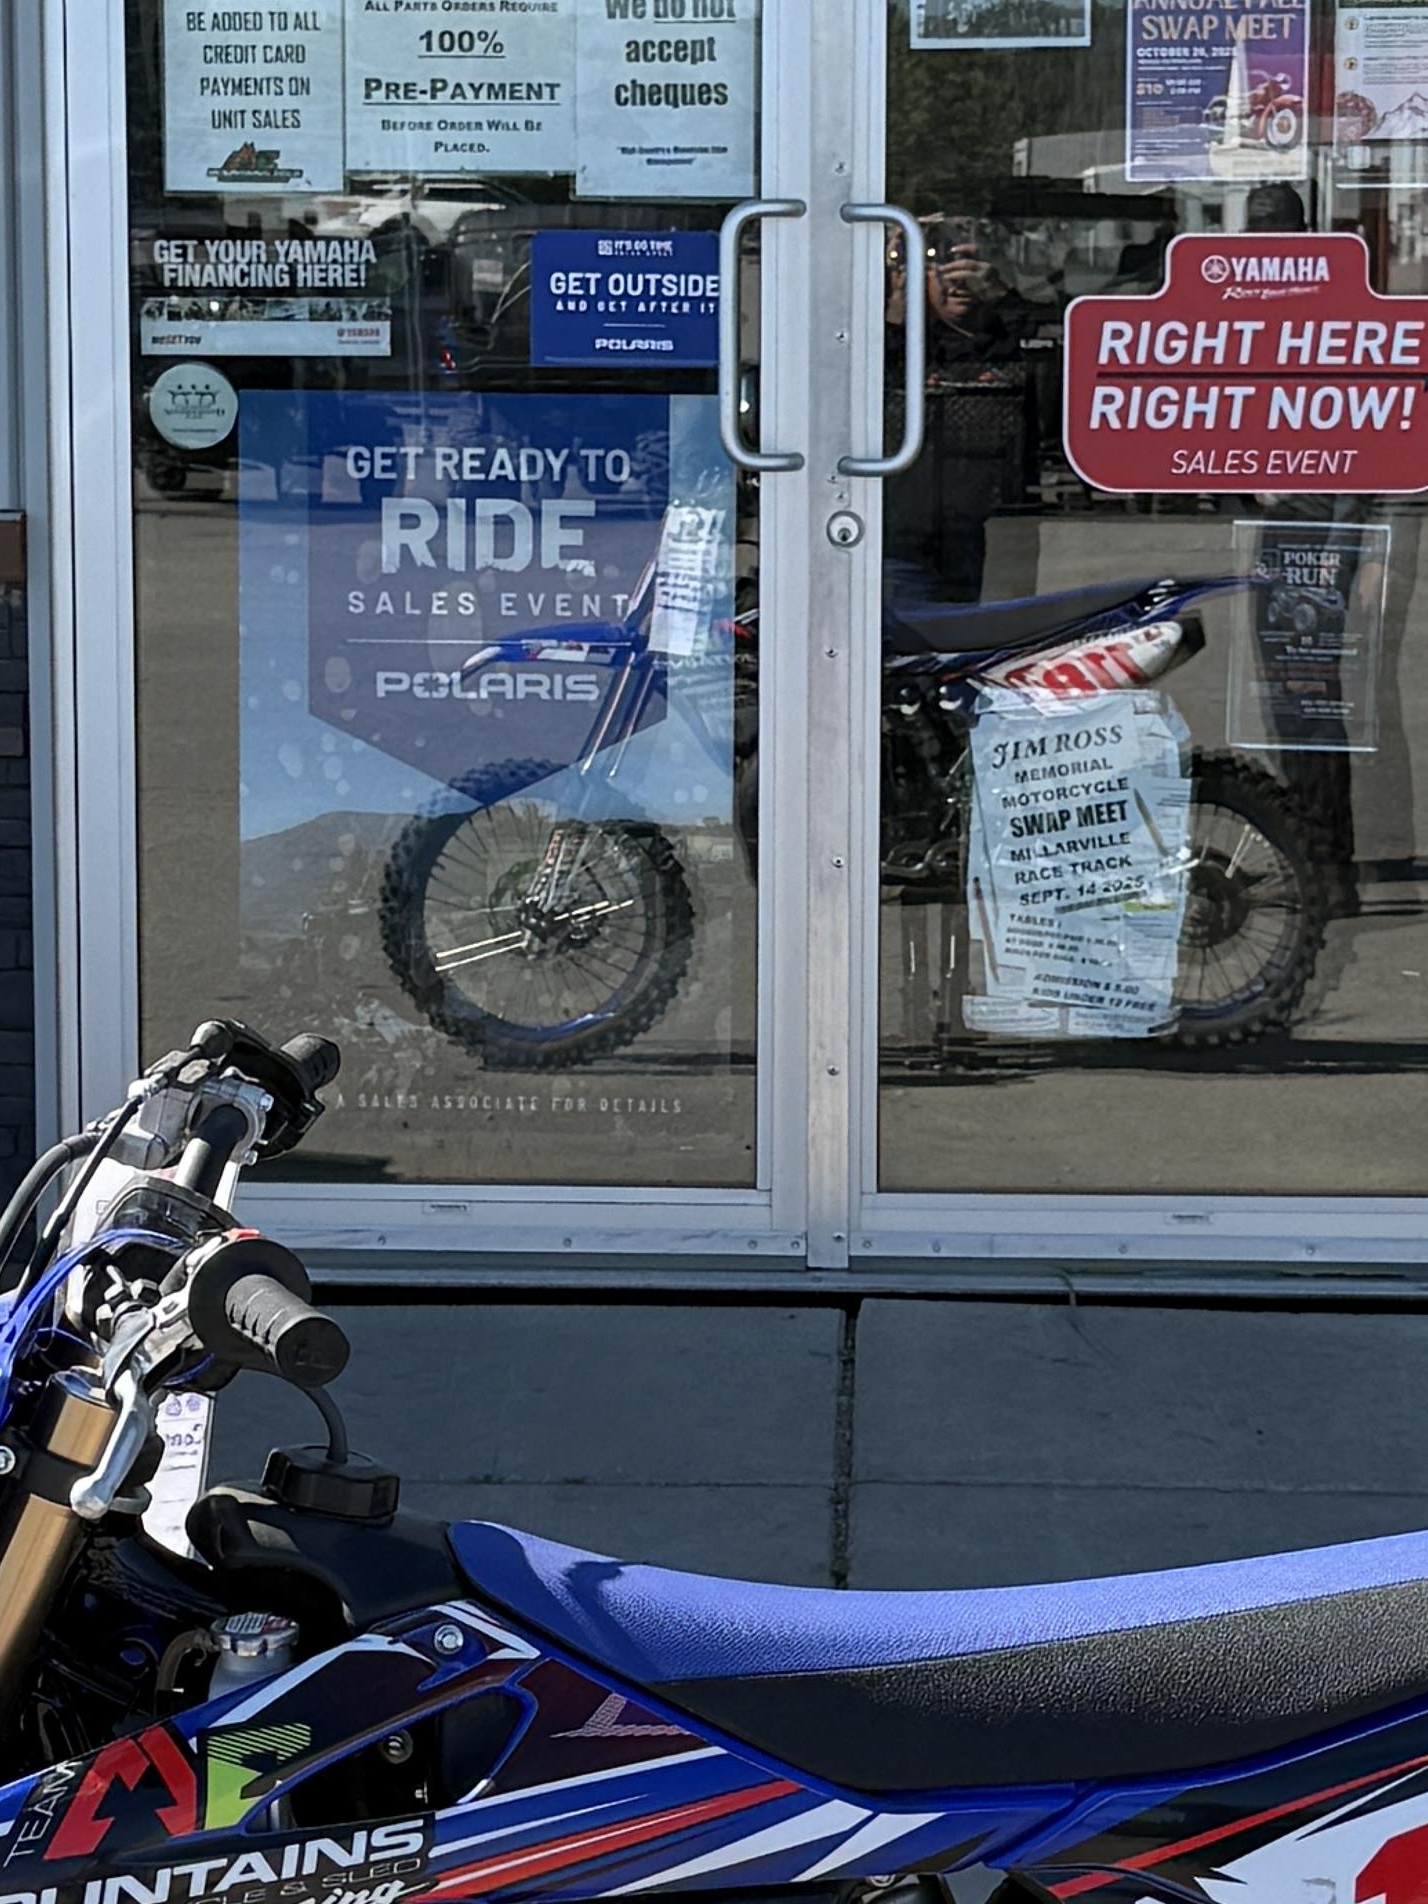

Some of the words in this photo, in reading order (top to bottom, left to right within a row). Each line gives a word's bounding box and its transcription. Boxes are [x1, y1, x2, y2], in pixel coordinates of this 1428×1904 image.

[186, 12, 207, 31] BE
[211, 11, 263, 32] ADDED
[269, 12, 288, 31] TO
[293, 11, 321, 31] ALL
[1141, 15, 1219, 41] SWAP
[1225, 14, 1296, 40] MEET
[203, 44, 257, 64] CREDIT
[263, 44, 306, 64] CARD
[419, 29, 504, 55] 100%
[625, 36, 717, 65] accept
[1136, 47, 1190, 57] OCTOBER
[200, 77, 284, 96] PAYMENTS
[289, 77, 311, 96] ON
[614, 79, 729, 108] cheques
[211, 109, 247, 129] UNIT
[252, 109, 301, 129] SALES
[153, 239, 199, 264] GET
[204, 240, 268, 264] YOUR
[274, 239, 377, 264] YAMAHA
[163, 264, 290, 287] FINANCING
[296, 264, 366, 287] HERE!
[1231, 256, 1330, 282] YAMAHA
[550, 272, 601, 295] GET
[608, 273, 720, 297] OUTSIDE
[555, 300, 588, 312] AND
[597, 300, 627, 312] GET
[637, 301, 690, 313] AFTER
[595, 338, 674, 351] POLARIS
[1097, 321, 1265, 365] RIGHT
[1276, 321, 1426, 365] HERE
[1088, 386, 1257, 430] RIGHT
[1267, 386, 1417, 431] NOW!
[346, 446, 425, 481] GET
[435, 446, 568, 482] READY
[580, 448, 632, 482] TO
[1171, 449, 1259, 475] SALES
[1265, 449, 1359, 475] EVENT
[380, 497, 597, 577] RIDE
[1283, 551, 1341, 566] POKER
[1285, 568, 1338, 586] RUN
[347, 591, 477, 616] SALES
[500, 593, 631, 618] EVENT
[375, 671, 601, 702] POLARIS
[992, 735, 1048, 770] JIM
[1052, 724, 1124, 755] ROSS
[1014, 757, 1114, 784] MEMORIAL
[1001, 777, 1131, 810] MOTORCYCLE
[1009, 810, 1073, 838] SWAP
[1076, 800, 1129, 827] MEET
[1009, 831, 1132, 863] MILLARVILLE
[1014, 865, 1063, 886] RACE
[1071, 854, 1133, 876] TRACK
[1019, 887, 1071, 907] SEPT.
[358, 1094, 419, 1109] SALES
[431, 1095, 539, 1111] ASSOCIATE
[282, 1877, 308, 1898] &
[320, 1857, 422, 1890] SLED
